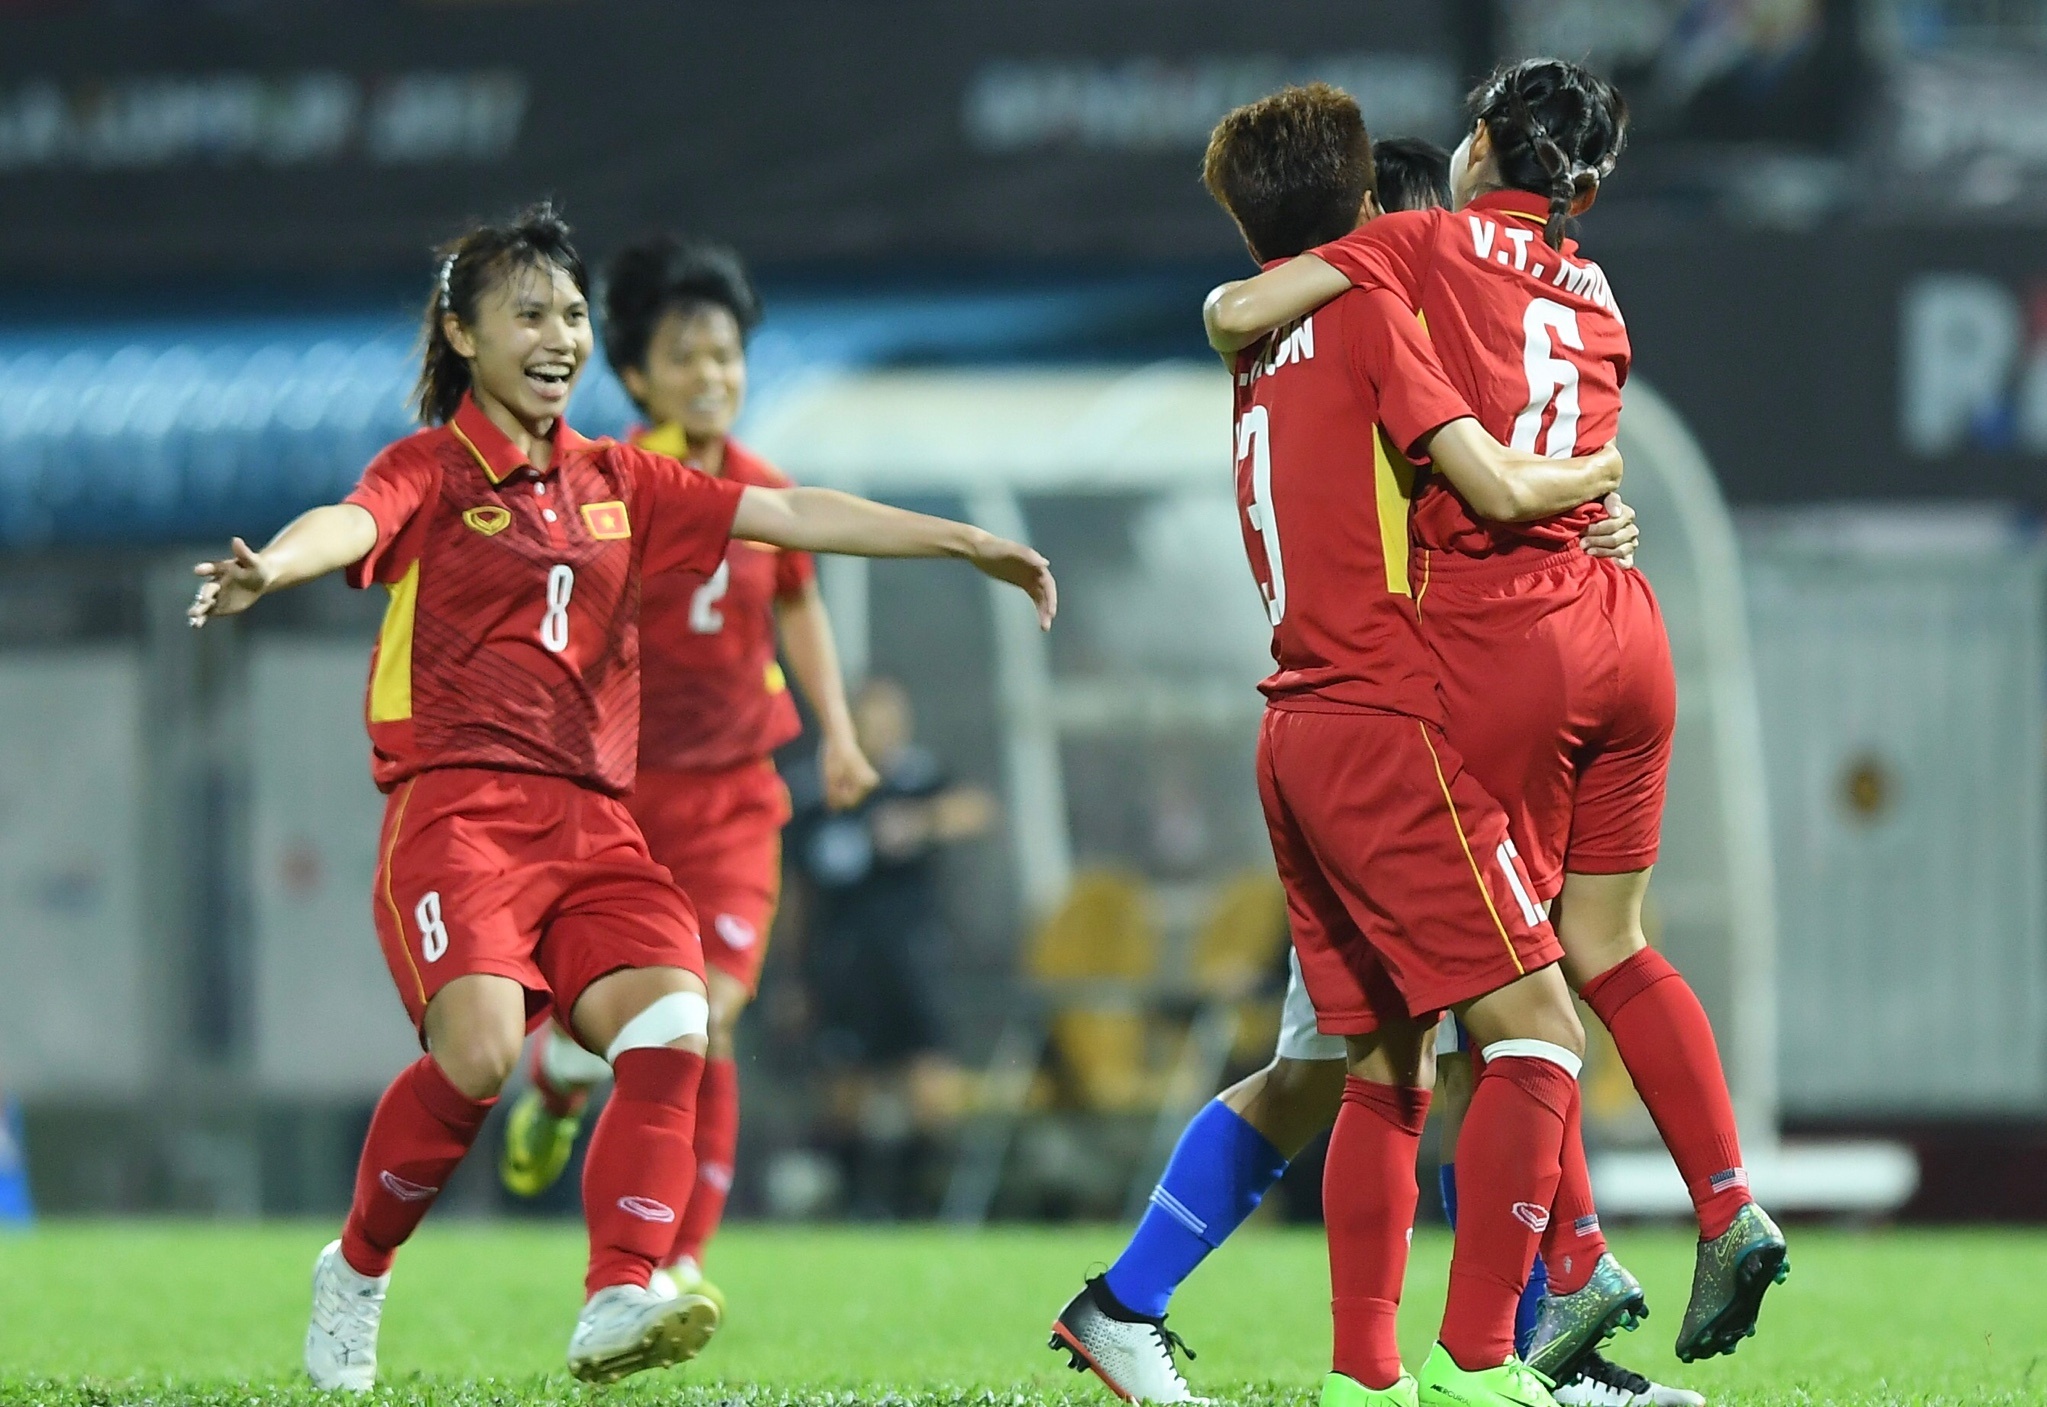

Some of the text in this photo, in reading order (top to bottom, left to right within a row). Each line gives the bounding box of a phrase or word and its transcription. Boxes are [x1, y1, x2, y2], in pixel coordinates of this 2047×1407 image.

[1468, 215, 1544, 279] V.T.
[1509, 297, 1585, 458] 6
[540, 563, 574, 653] 8
[688, 557, 730, 635] 2
[414, 890, 449, 963] 8
